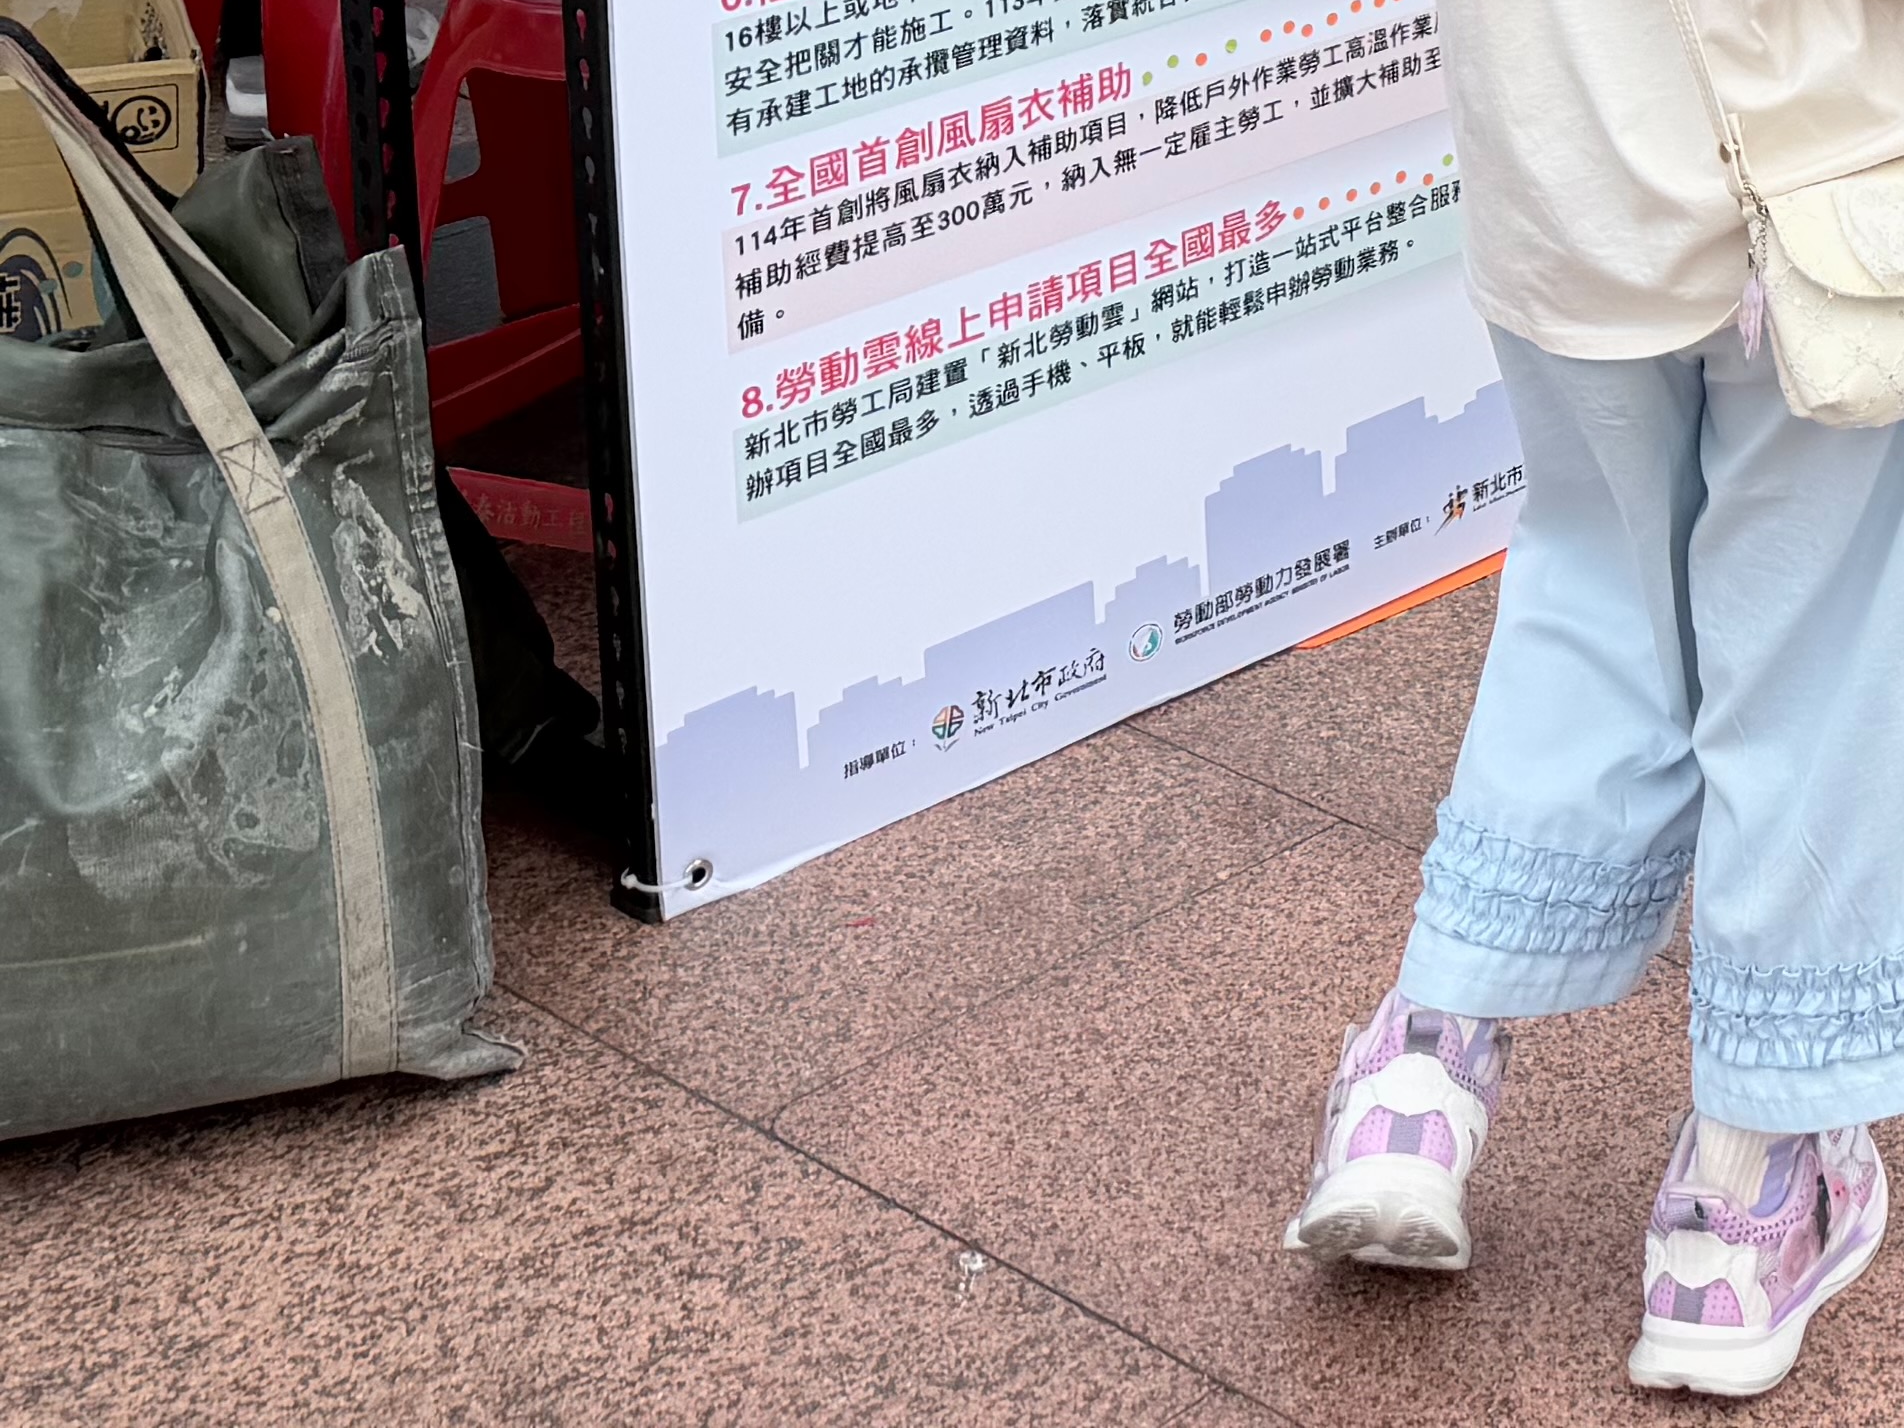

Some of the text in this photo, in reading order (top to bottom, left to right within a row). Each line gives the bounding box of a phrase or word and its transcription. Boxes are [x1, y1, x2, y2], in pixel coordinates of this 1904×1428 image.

[731, 60, 1132, 218] 7.全國首創風扇衣補助
[733, 12, 1439, 255] 114年首創將風扇衣納入補助項目，降低戶外作業勞工高溫作業
[737, 305, 788, 343] 備。
[741, 201, 1286, 419] 8.勞動雲線上申請項目全國最多
[1173, 539, 1350, 635] 勞動部勞動力發展署
[971, 647, 1105, 724] 新北市政府
